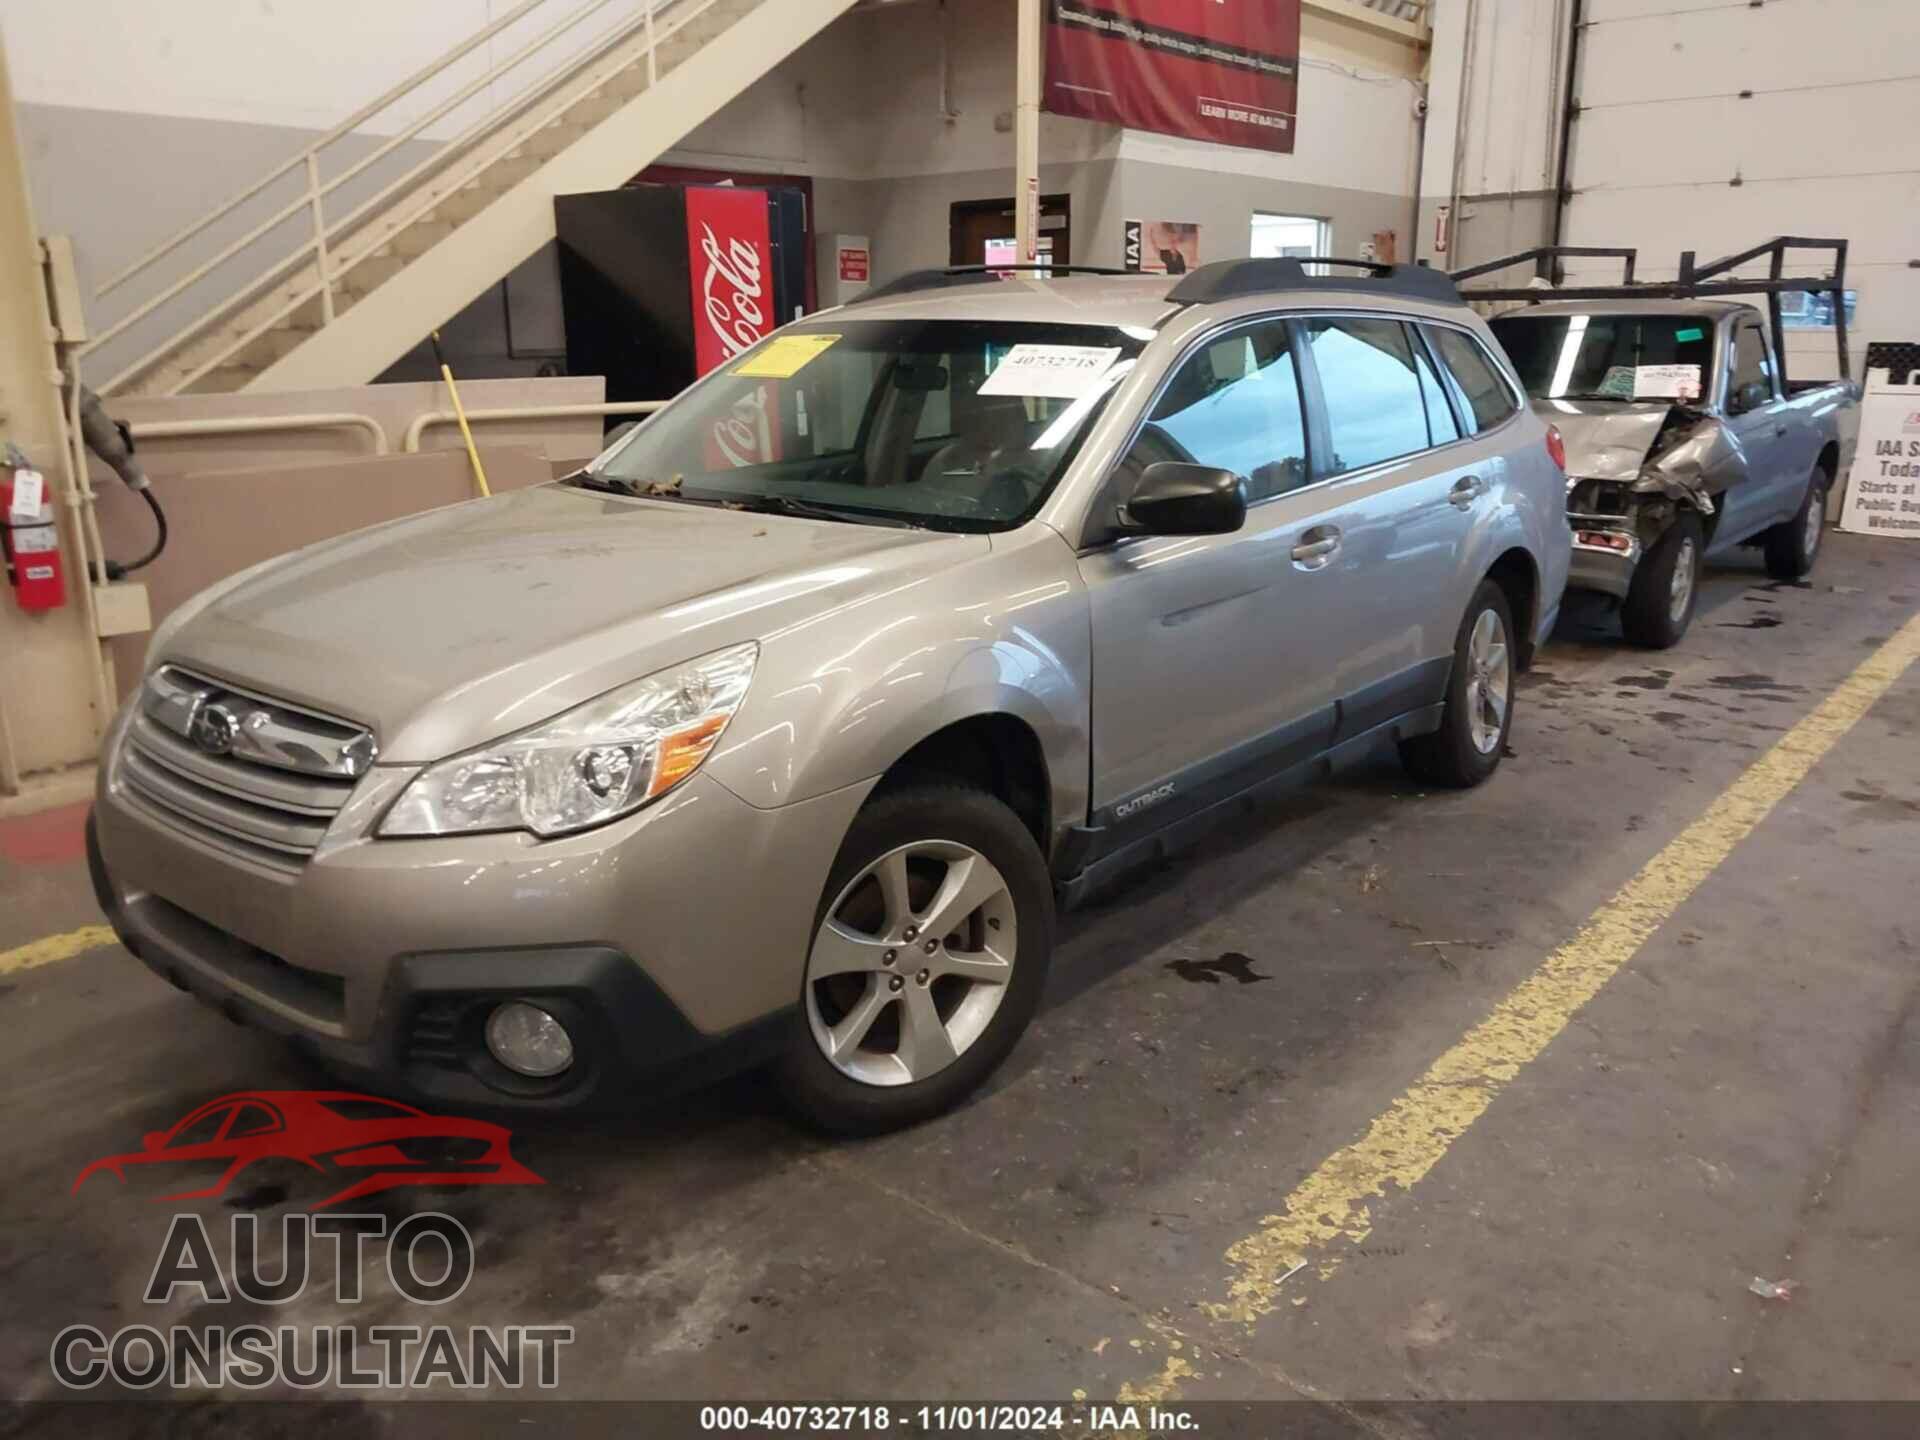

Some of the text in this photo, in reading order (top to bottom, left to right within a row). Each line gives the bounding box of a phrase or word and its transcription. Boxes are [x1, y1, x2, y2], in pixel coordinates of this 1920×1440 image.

[1127, 227, 1139, 264] IAA
[702, 220, 764, 358] Cola
[1876, 440, 1902, 456] IAA
[1859, 481, 1915, 495] Starts at
[1856, 498, 1897, 511] Public
[1116, 782, 1175, 816] OUTBACK
